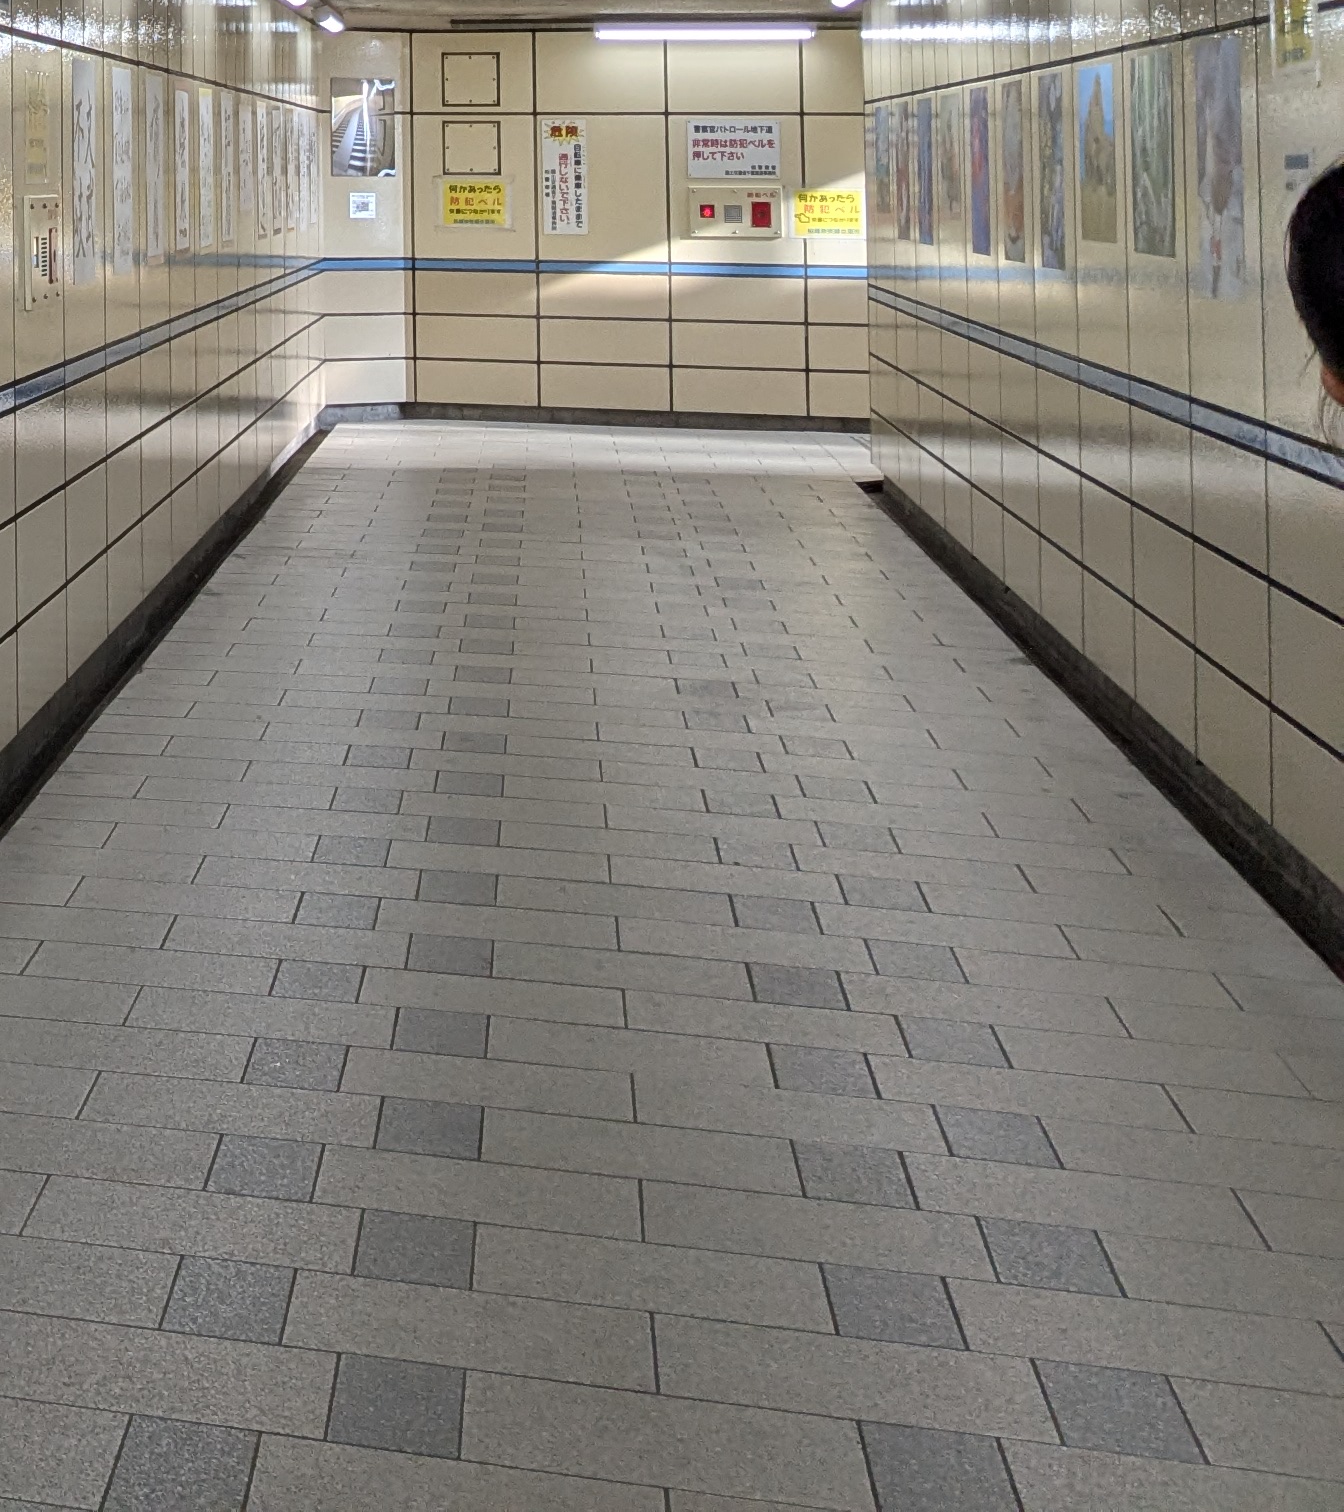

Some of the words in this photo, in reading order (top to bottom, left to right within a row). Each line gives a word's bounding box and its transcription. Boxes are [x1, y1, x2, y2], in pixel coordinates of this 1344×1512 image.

[550, 125, 579, 137] 危険
[693, 125, 773, 134] 警察官パトロール地下道
[692, 138, 776, 149] 非常時は防犯ベルを
[692, 151, 745, 161] 押して下さい
[448, 185, 502, 194] 何かあったら
[449, 196, 502, 206] 防犯ベル
[797, 193, 856, 203] 何かあったら
[803, 204, 861, 214] 防犯ベル
